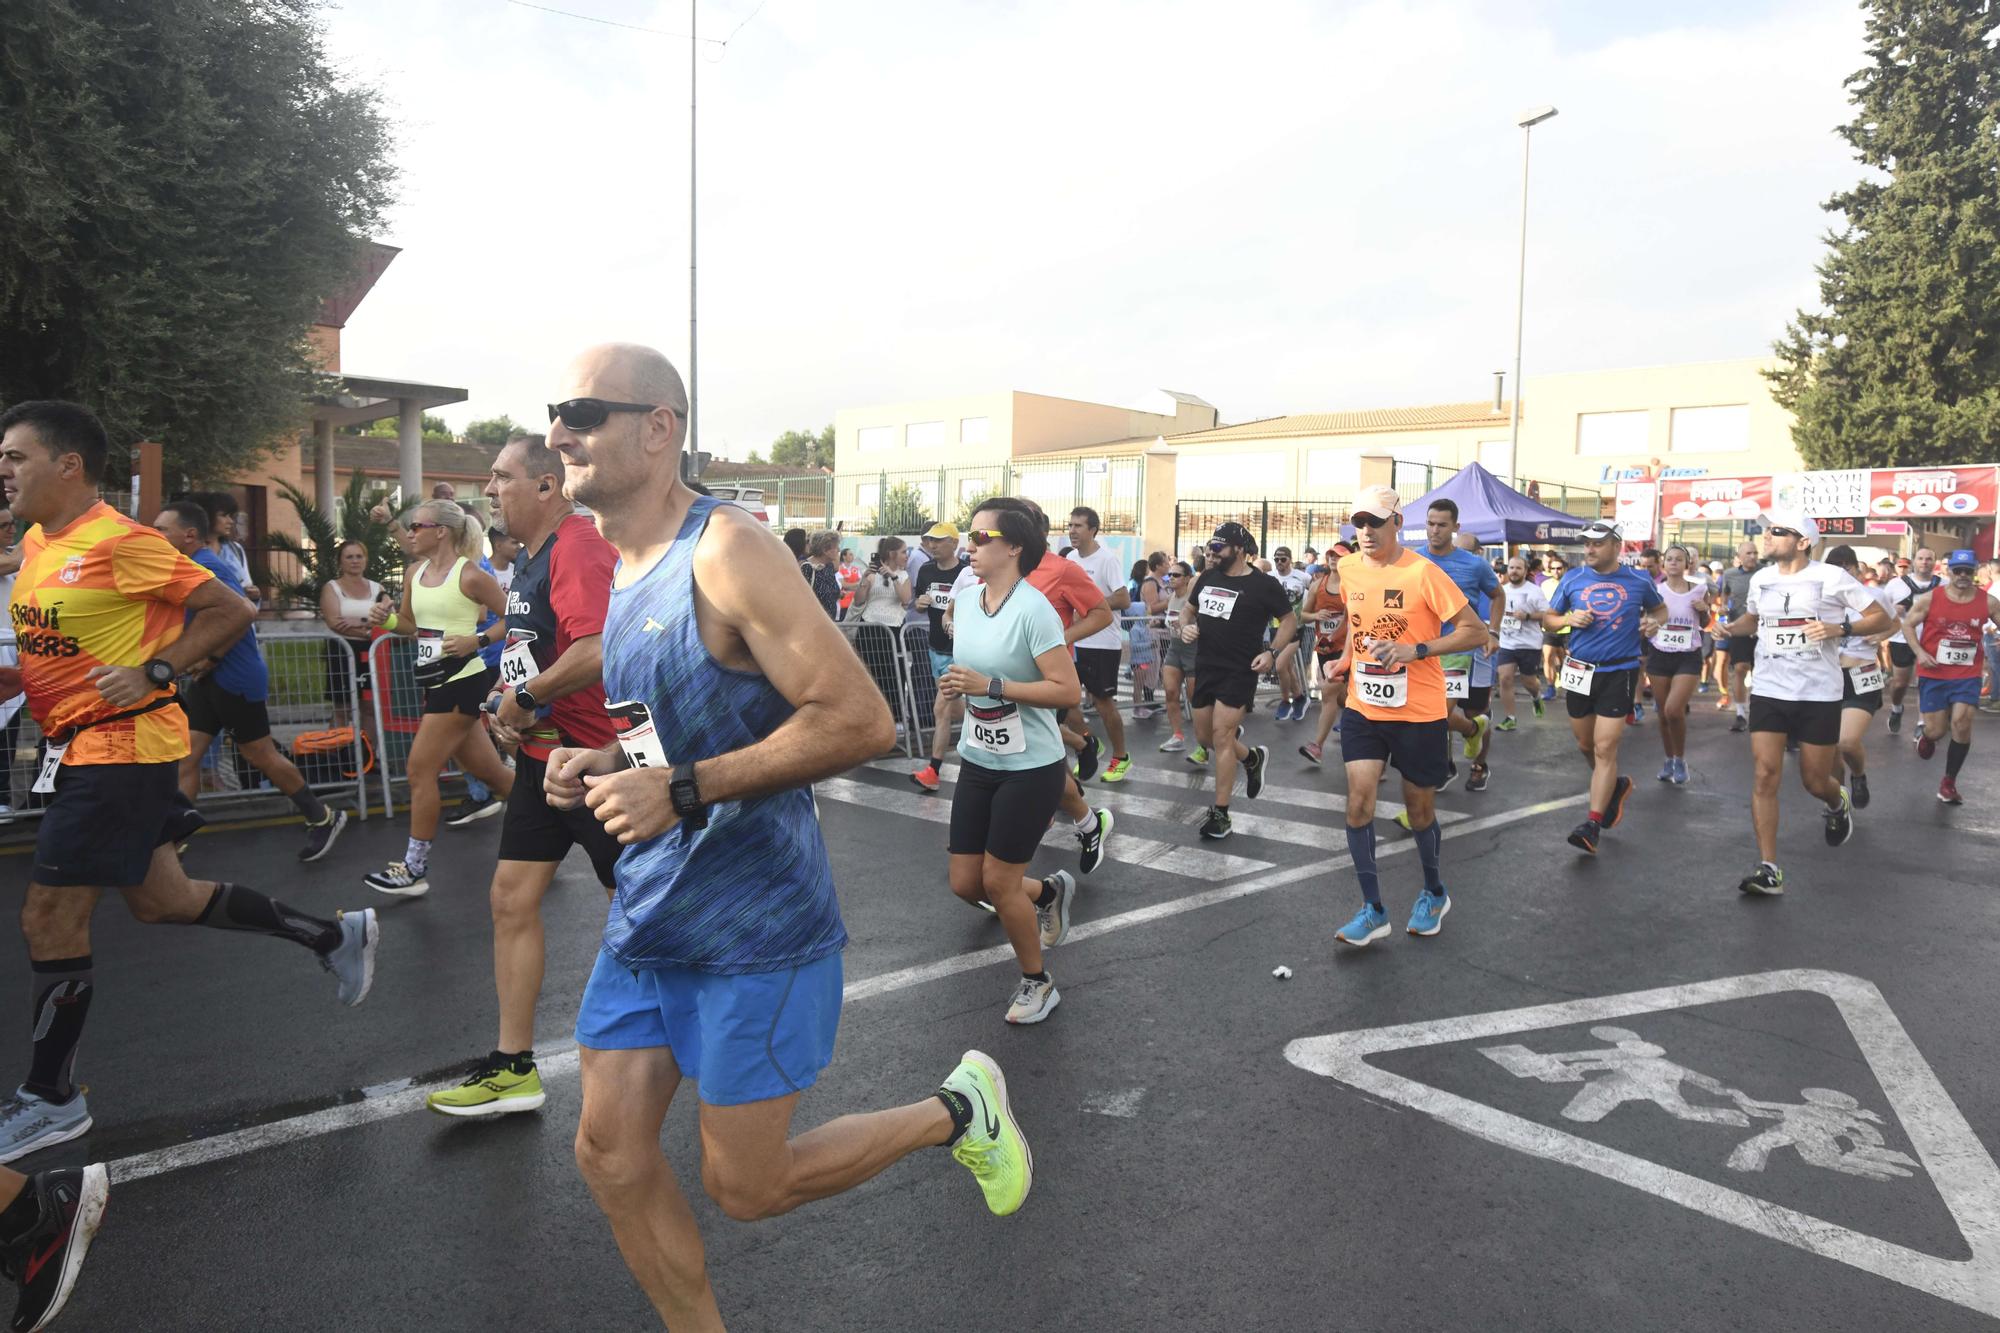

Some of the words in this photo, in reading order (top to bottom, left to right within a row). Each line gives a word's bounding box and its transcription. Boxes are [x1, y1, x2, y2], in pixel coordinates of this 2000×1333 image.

[935, 595, 951, 604] 08
[1203, 599, 1225, 612] 128
[1323, 621, 1339, 630] 60
[1373, 621, 1398, 630] MURCIA
[1663, 633, 1685, 645] 246
[1775, 632, 1807, 646] 571
[419, 644, 433, 658] 30
[1946, 651, 1969, 662] 139
[503, 656, 527, 683] 334
[1563, 671, 1584, 687] 137
[1362, 682, 1395, 699] 320
[1446, 682, 1462, 692] 24
[974, 724, 1010, 746] 055
